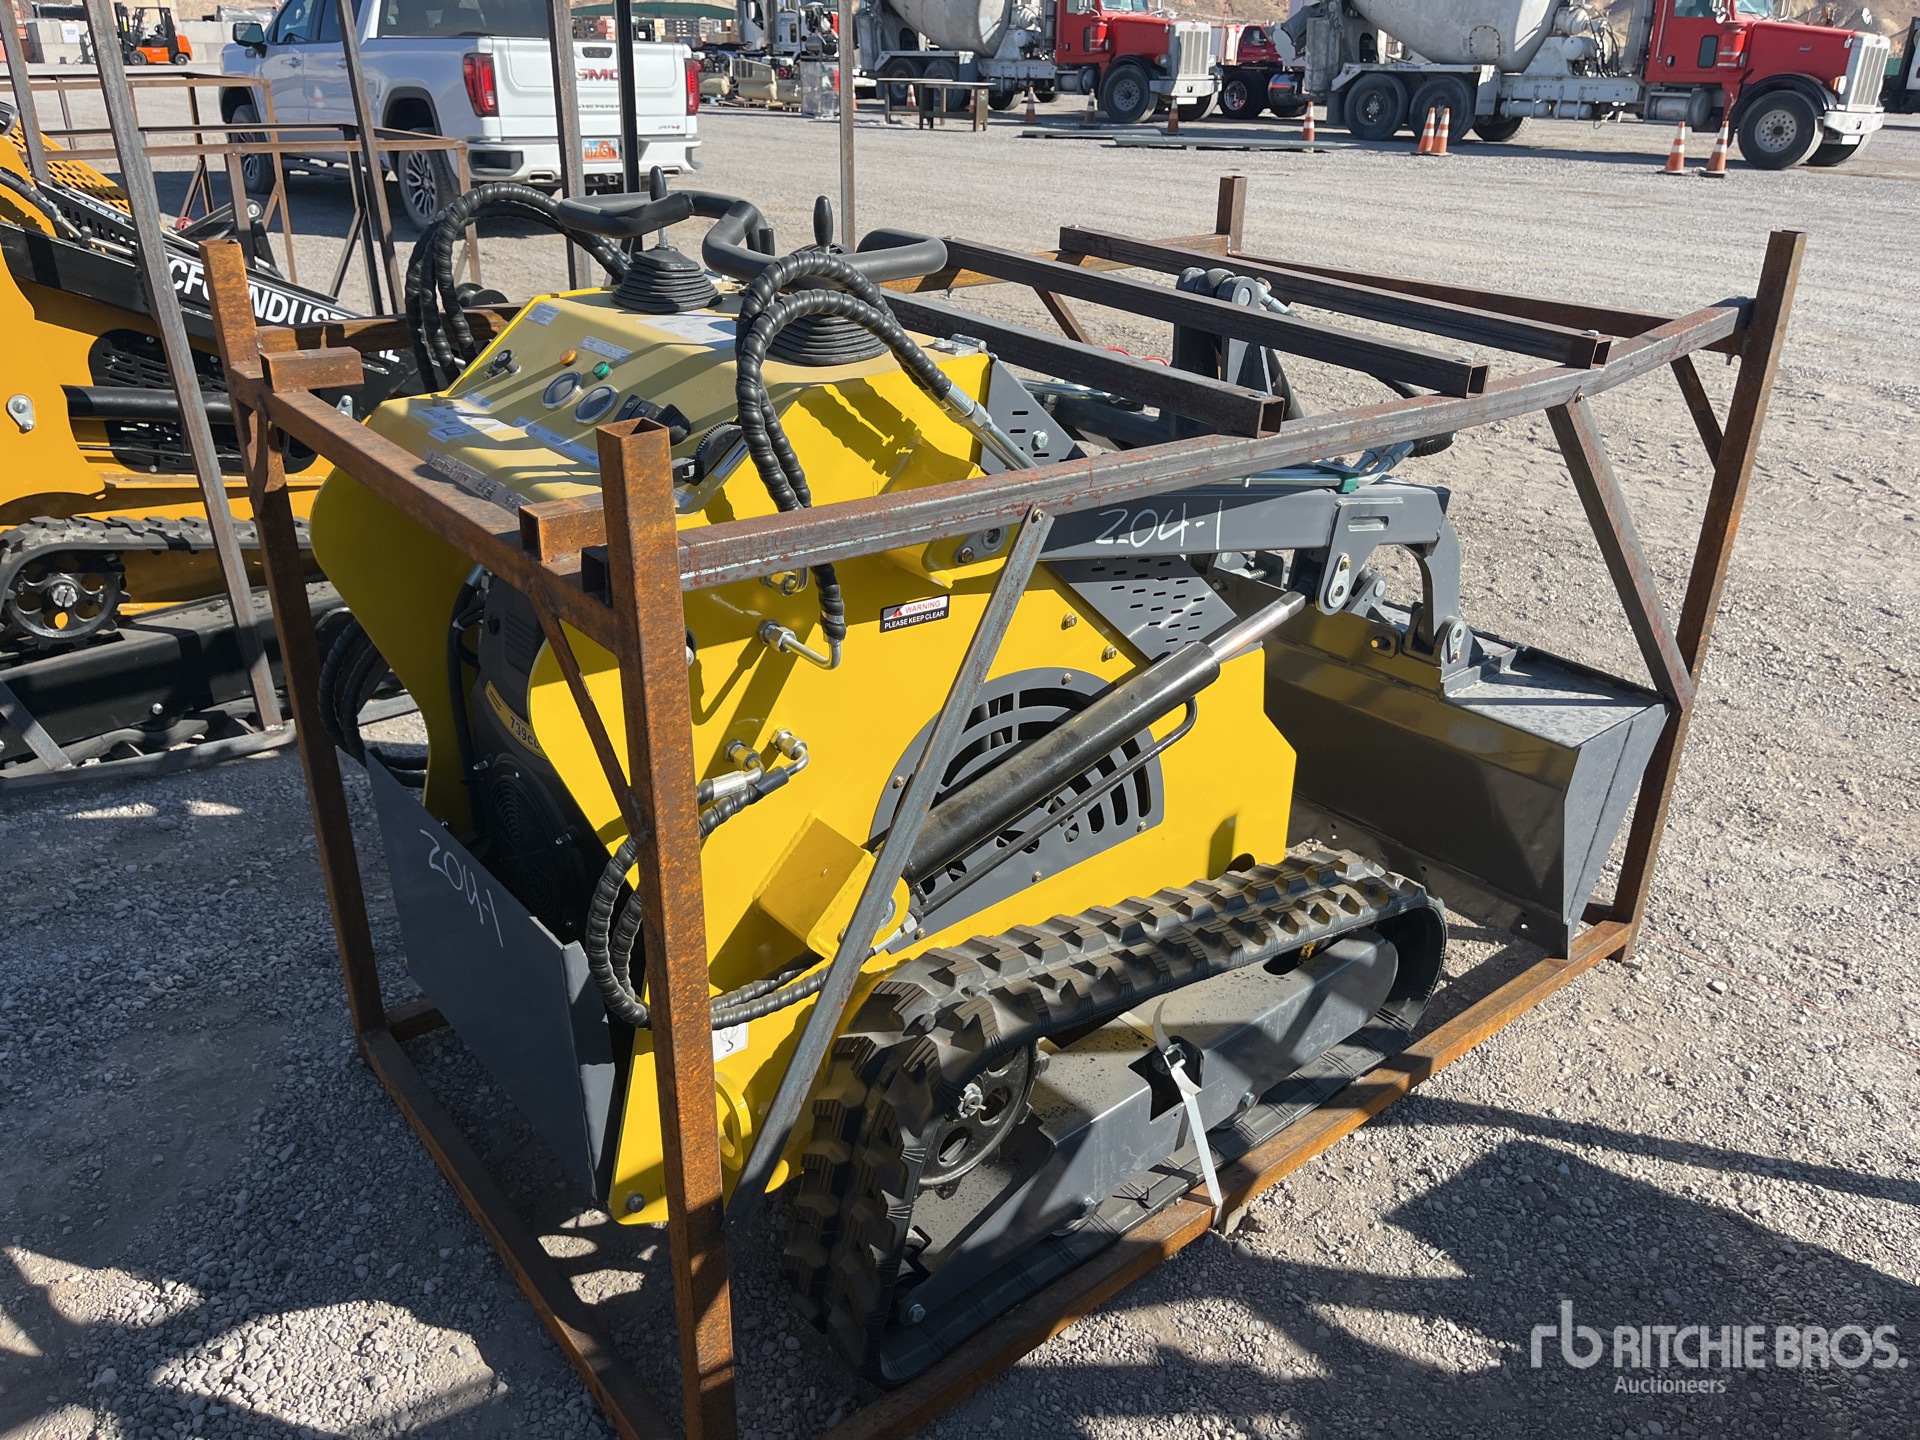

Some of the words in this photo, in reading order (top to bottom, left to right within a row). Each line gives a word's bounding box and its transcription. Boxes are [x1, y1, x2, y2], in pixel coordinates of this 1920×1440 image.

[1095, 499, 1223, 550] 204-1
[905, 600, 941, 614] WARNING
[884, 618, 908, 630] PLEASE
[909, 614, 924, 624] KEEP
[925, 610, 945, 620] CLEAR
